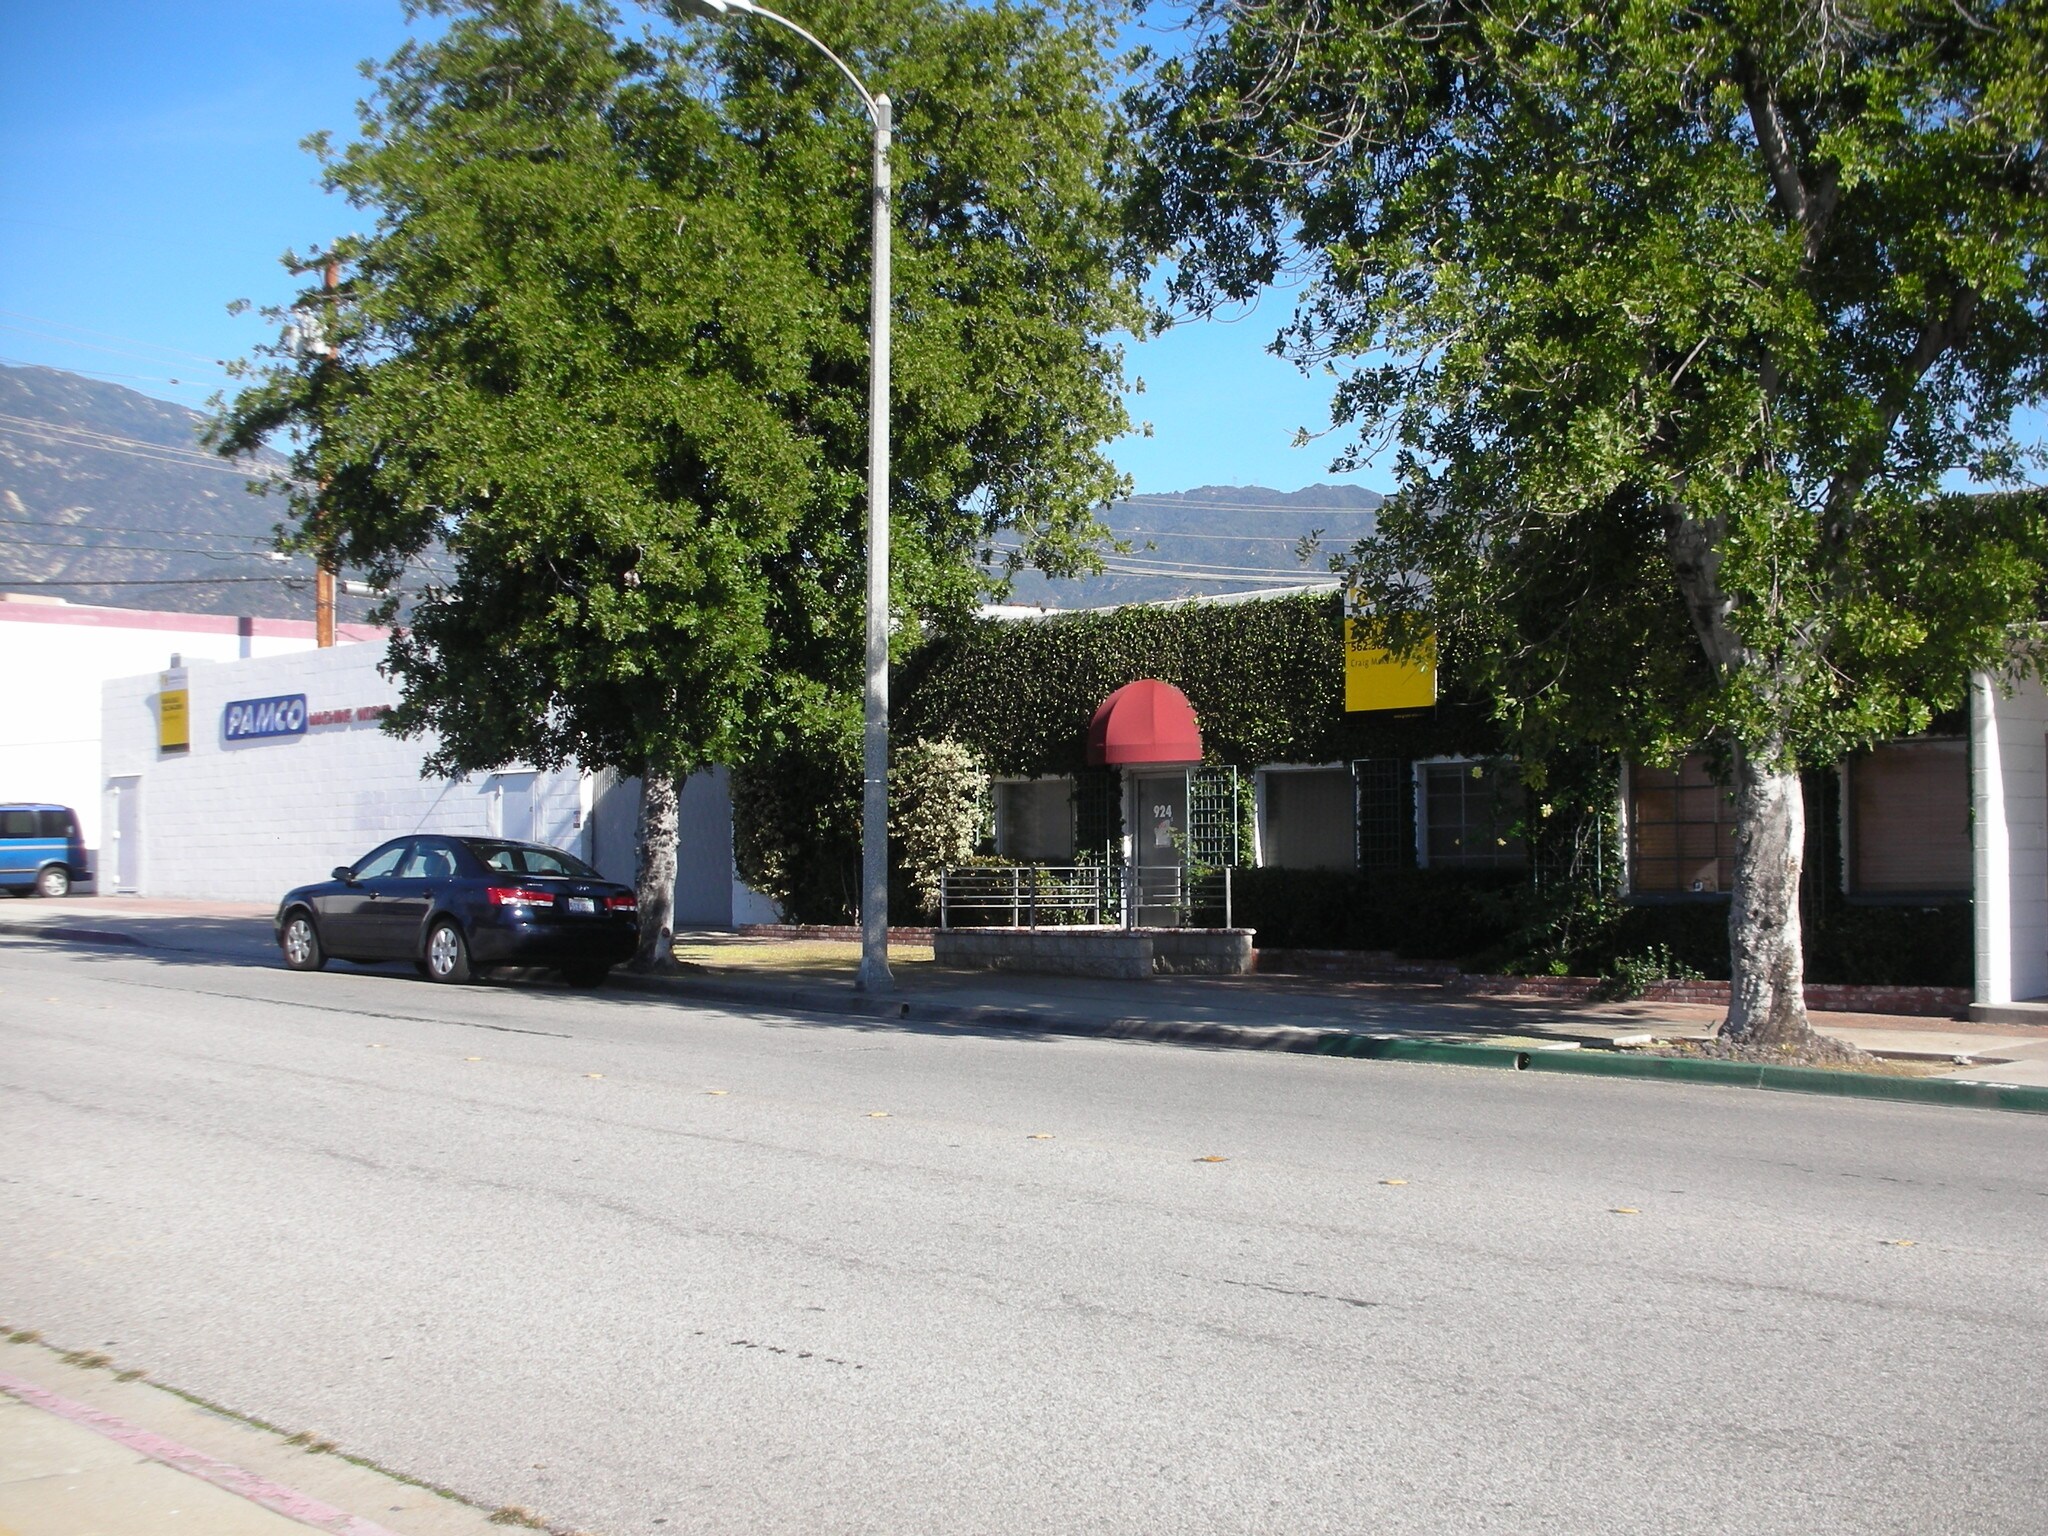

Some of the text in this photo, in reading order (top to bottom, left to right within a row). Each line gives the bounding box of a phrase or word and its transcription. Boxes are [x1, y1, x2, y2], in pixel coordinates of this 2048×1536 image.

[1351, 659, 1369, 669] Craig
[227, 700, 304, 735] PAMCO
[309, 709, 352, 726] MACHINE
[1153, 804, 1172, 818] 924
